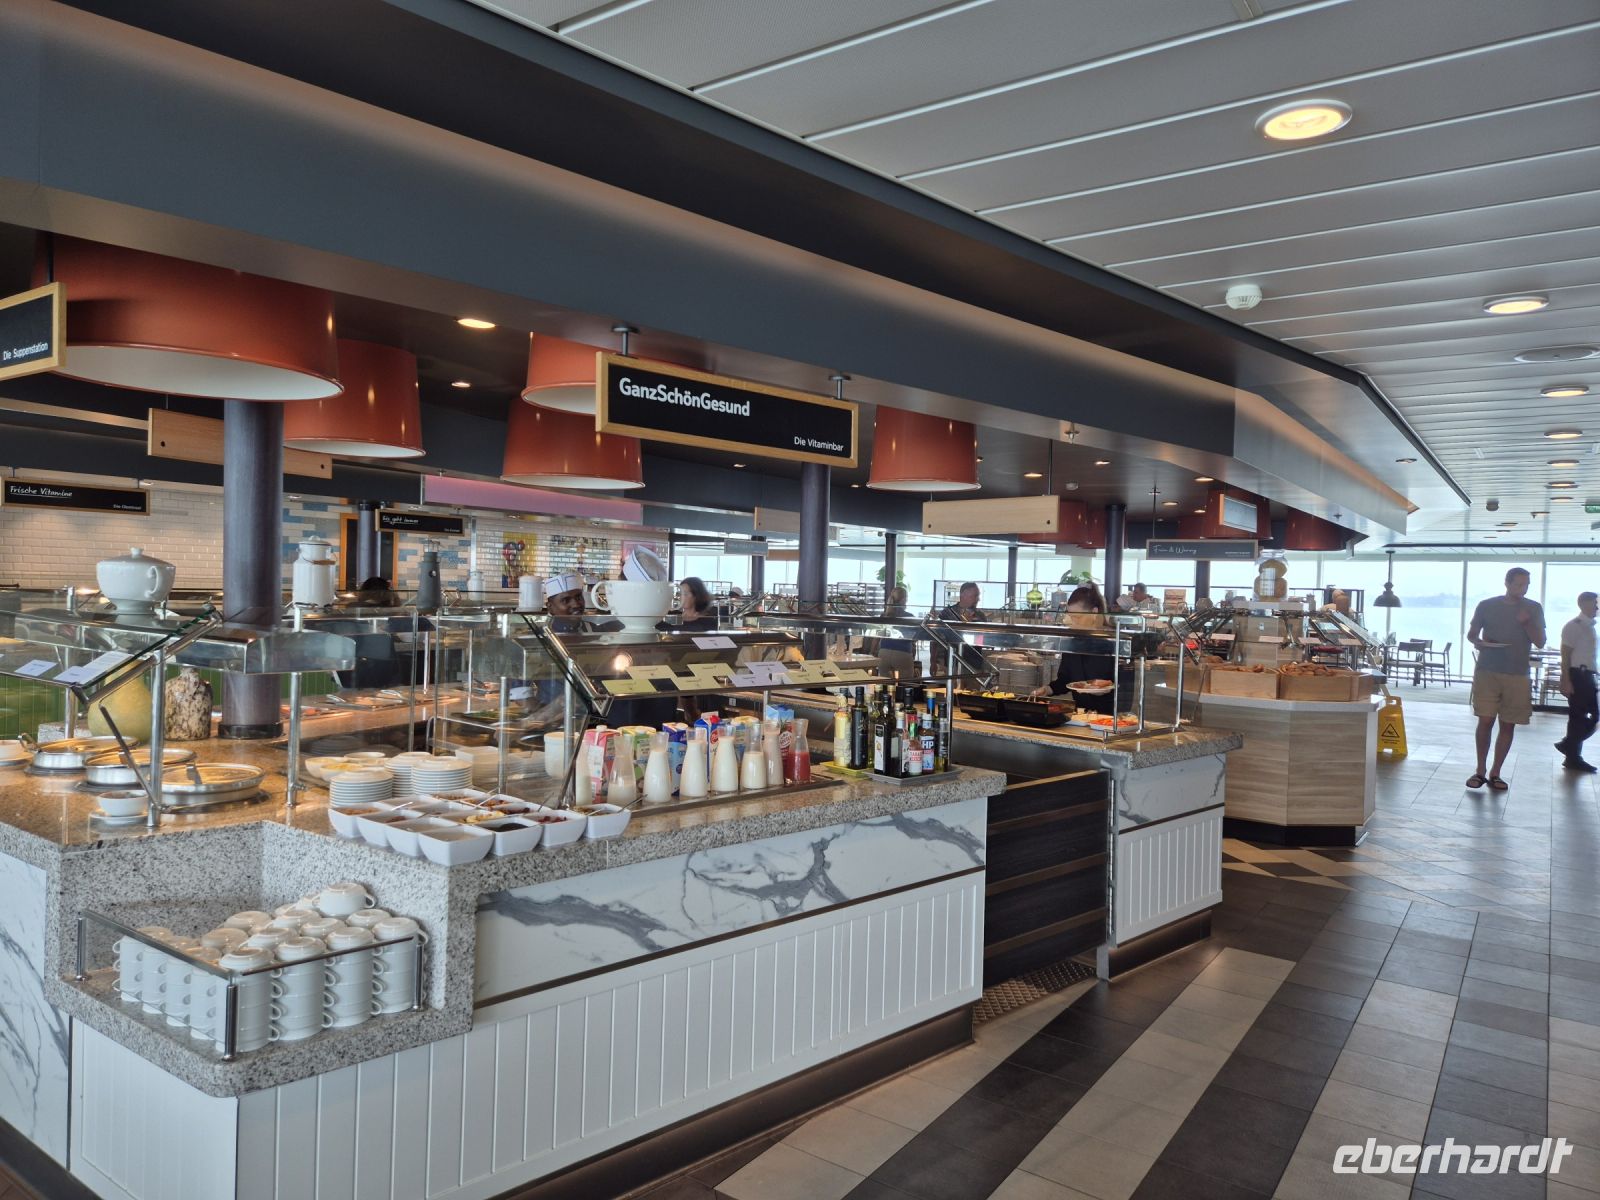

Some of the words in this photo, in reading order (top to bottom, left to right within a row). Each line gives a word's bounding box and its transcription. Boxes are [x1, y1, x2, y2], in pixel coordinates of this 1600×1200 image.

[3, 350, 12, 360] Die
[13, 342, 49, 358] Suppenstation
[619, 377, 750, 416] GanzSchönGesund
[794, 436, 806, 446] Die
[807, 438, 844, 452] Vitaminbar
[10, 485, 37, 494] Frische
[40, 487, 73, 497] Vitamine
[922, 740, 934, 749] HP
